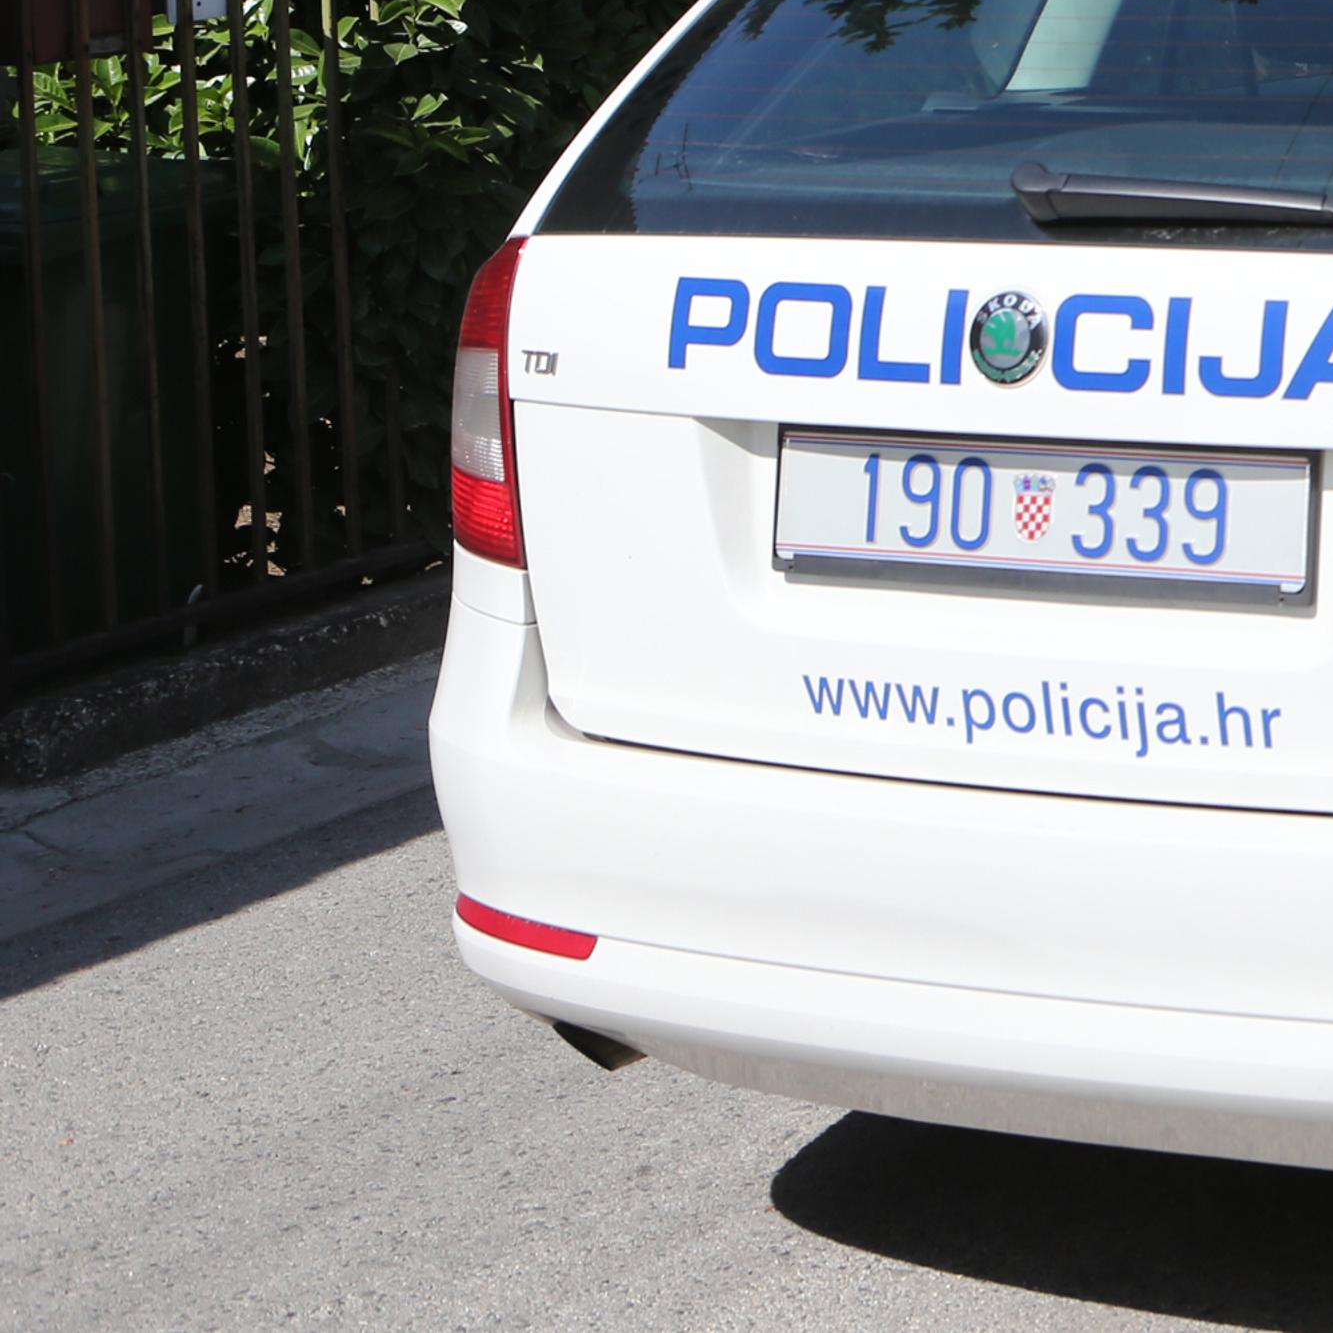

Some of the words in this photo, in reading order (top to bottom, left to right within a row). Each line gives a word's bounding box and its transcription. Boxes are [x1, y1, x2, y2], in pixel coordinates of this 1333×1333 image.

[521, 349, 559, 376] TDI
[862, 452, 994, 551] 190
[1071, 461, 1229, 566] 339
[802, 673, 1282, 758] www.policija.hr
